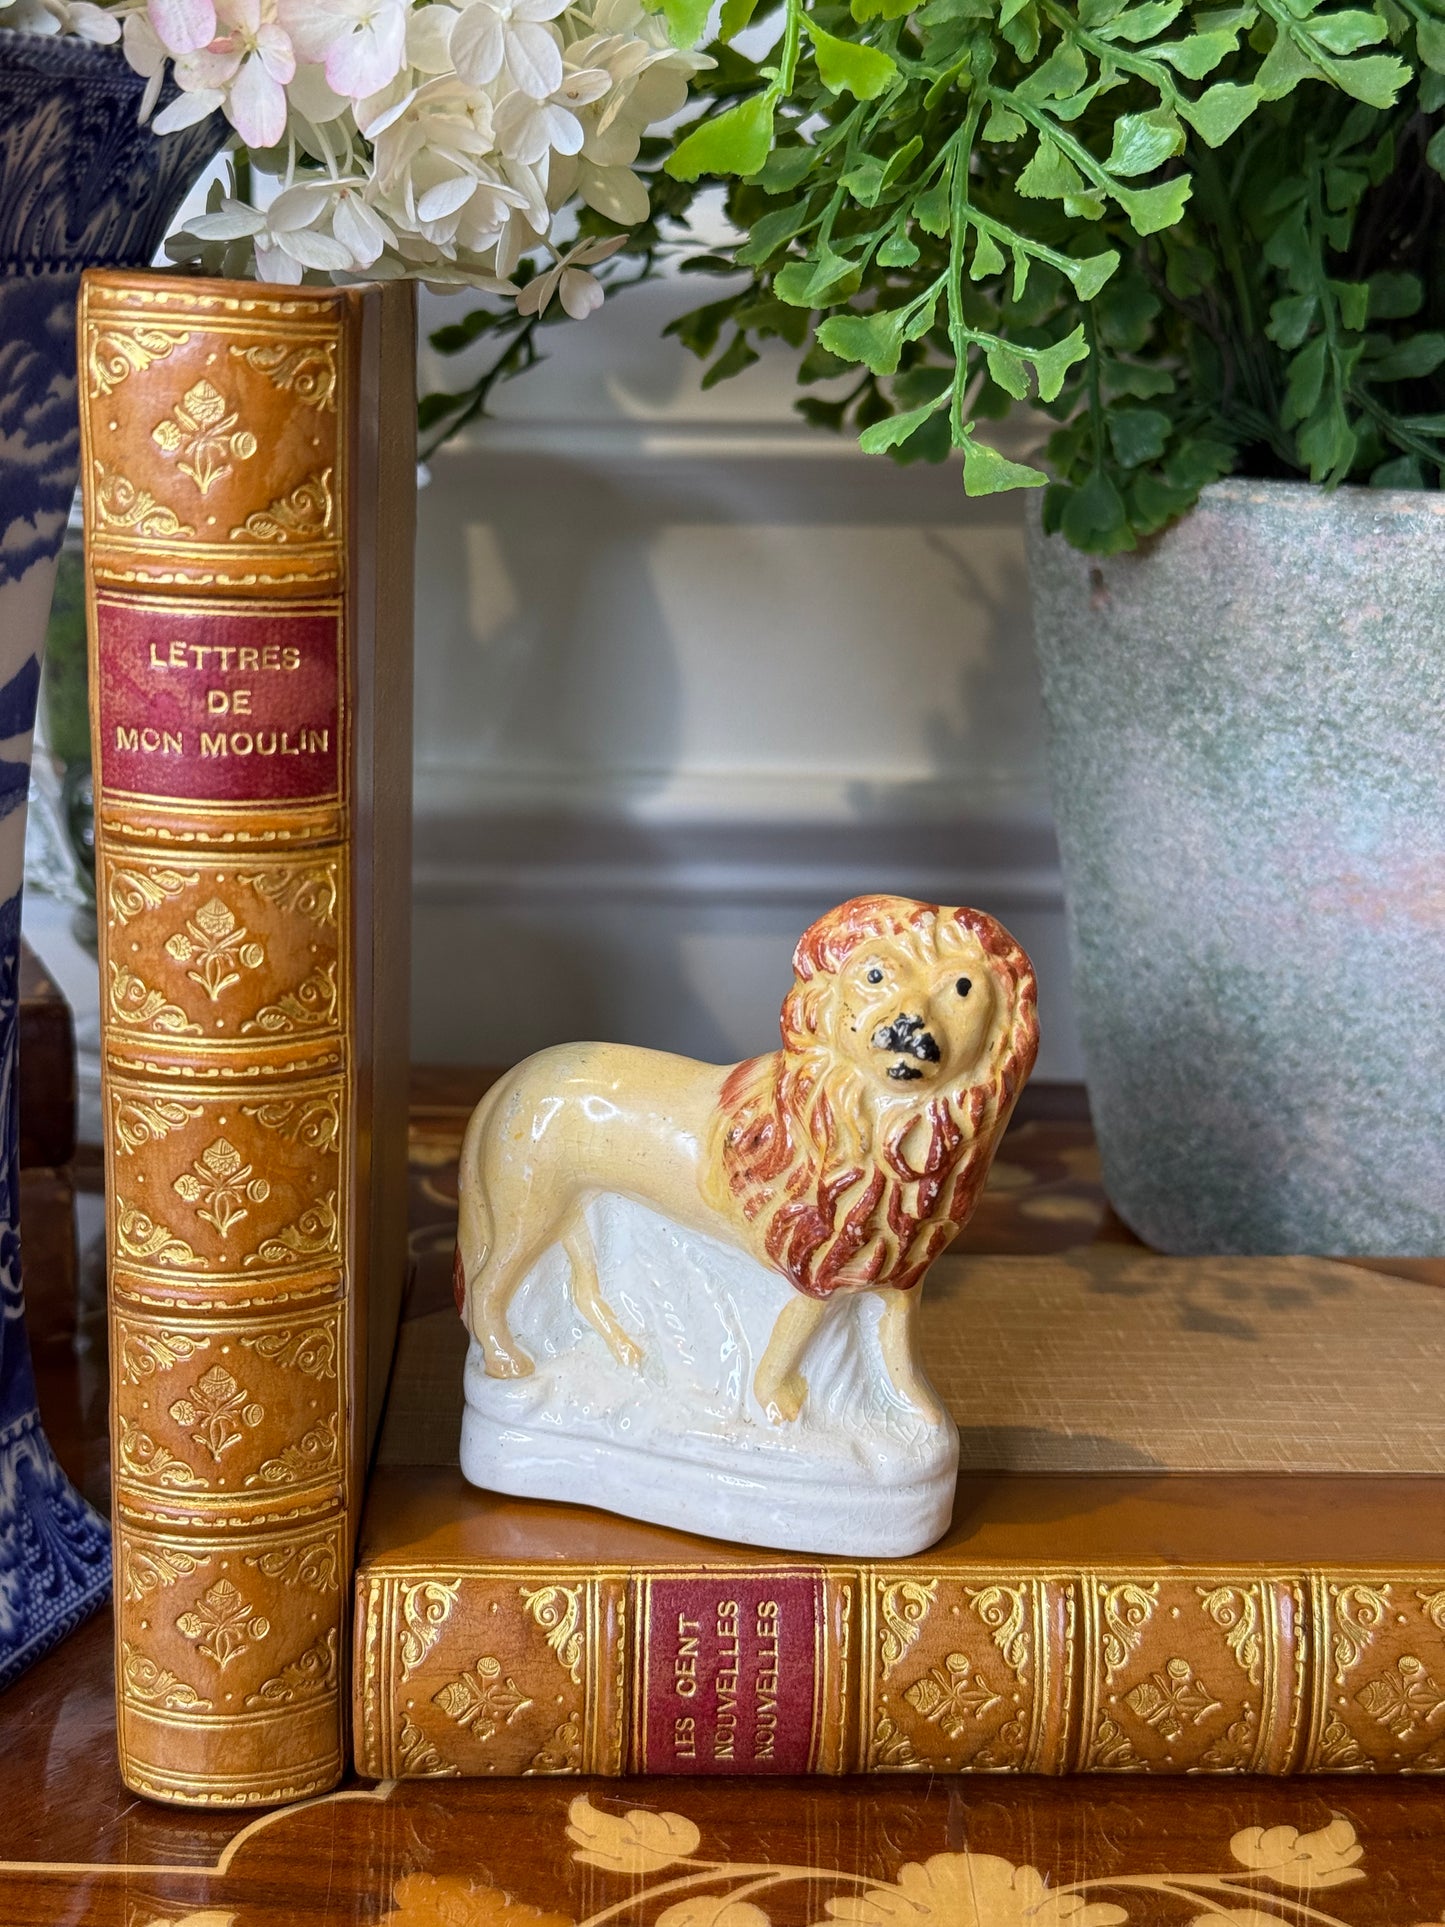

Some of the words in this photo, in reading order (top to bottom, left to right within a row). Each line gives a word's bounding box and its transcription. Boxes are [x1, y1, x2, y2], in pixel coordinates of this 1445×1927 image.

[150, 640, 300, 672] LETTRES
[207, 690, 252, 715] DE
[116, 726, 183, 755] MON
[200, 729, 329, 757] MOULIN
[675, 1612, 699, 1697] CENT
[714, 1600, 739, 1760] NOUVELLES
[755, 1600, 779, 1760] NOUVELLES
[675, 1717, 696, 1759] LES
